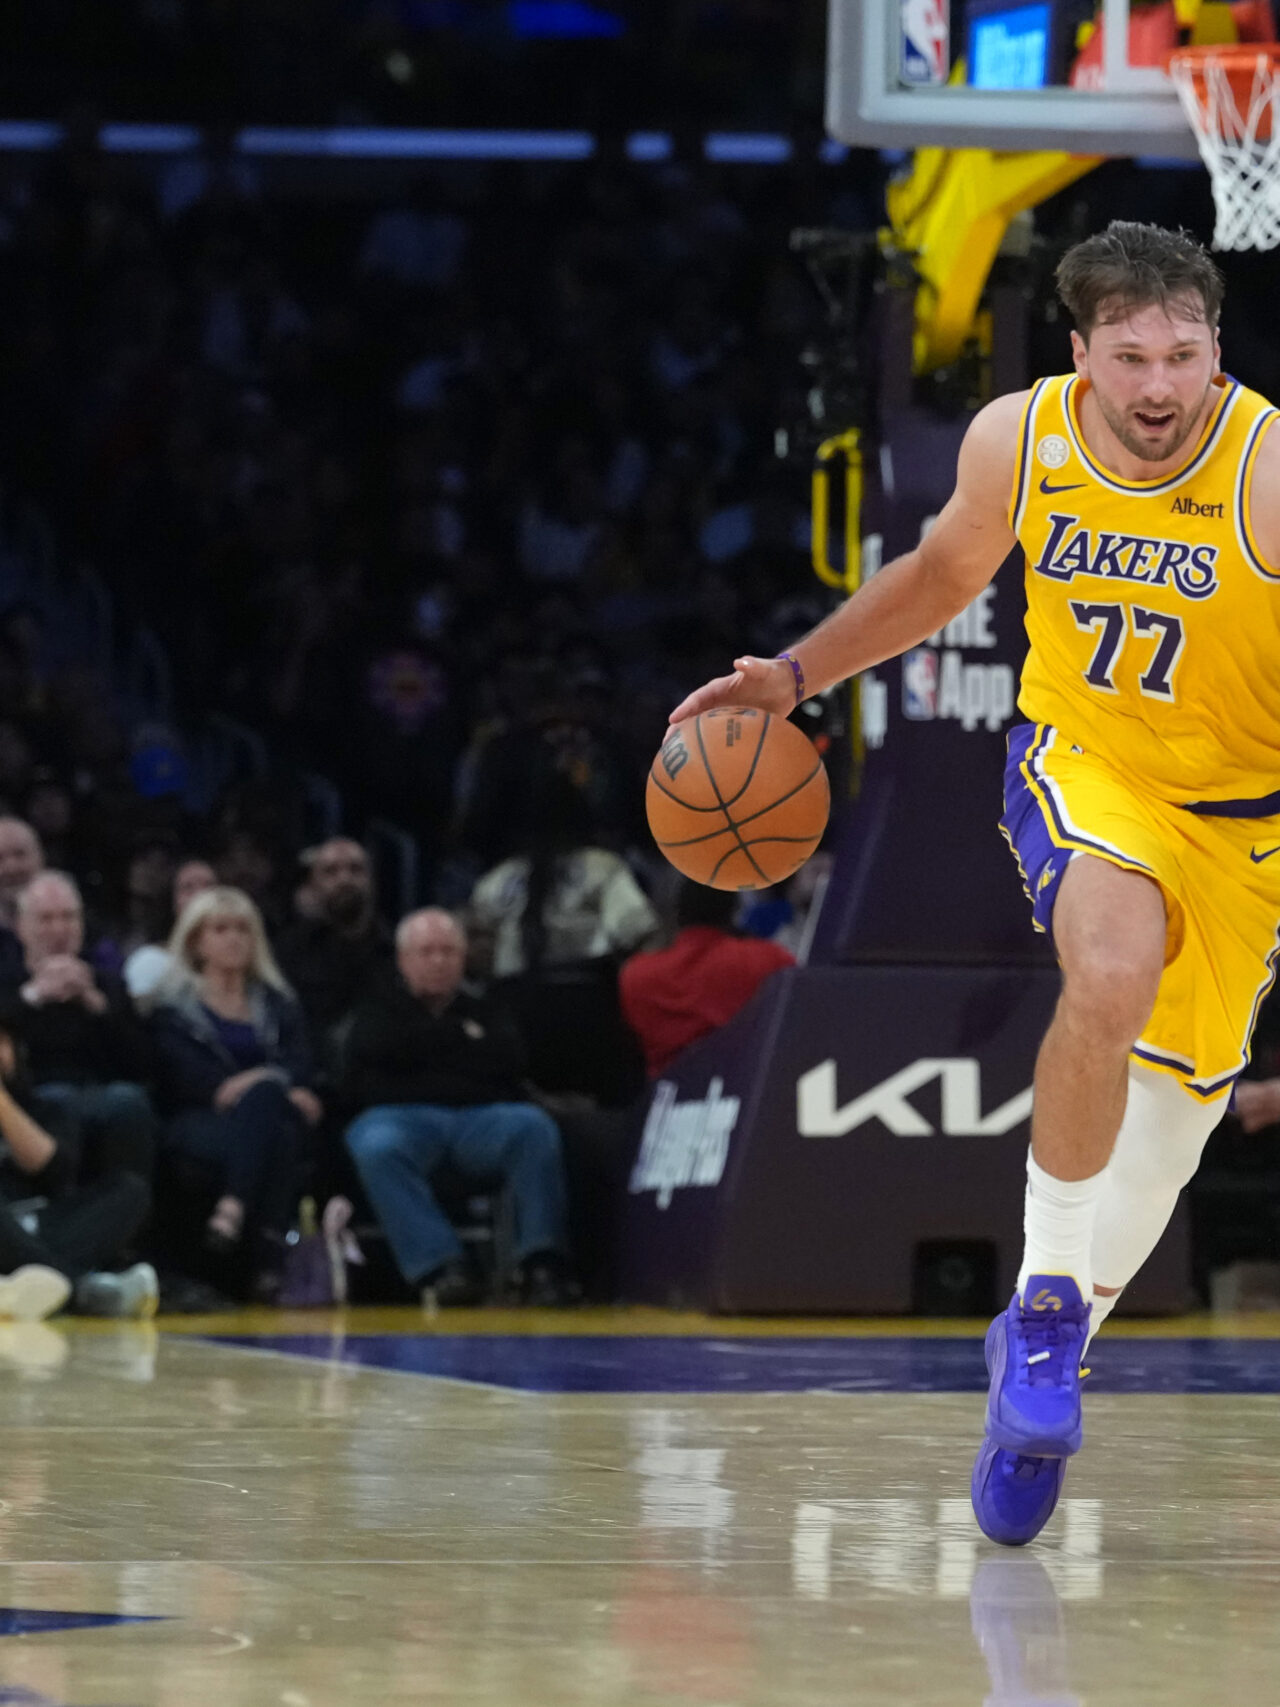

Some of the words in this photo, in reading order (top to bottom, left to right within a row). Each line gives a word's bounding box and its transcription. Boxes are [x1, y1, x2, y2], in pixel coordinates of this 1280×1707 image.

[1170, 496, 1225, 519] Albert
[1033, 512, 1219, 602] LAKERS
[938, 651, 1014, 732] App
[1067, 600, 1187, 703] 77
